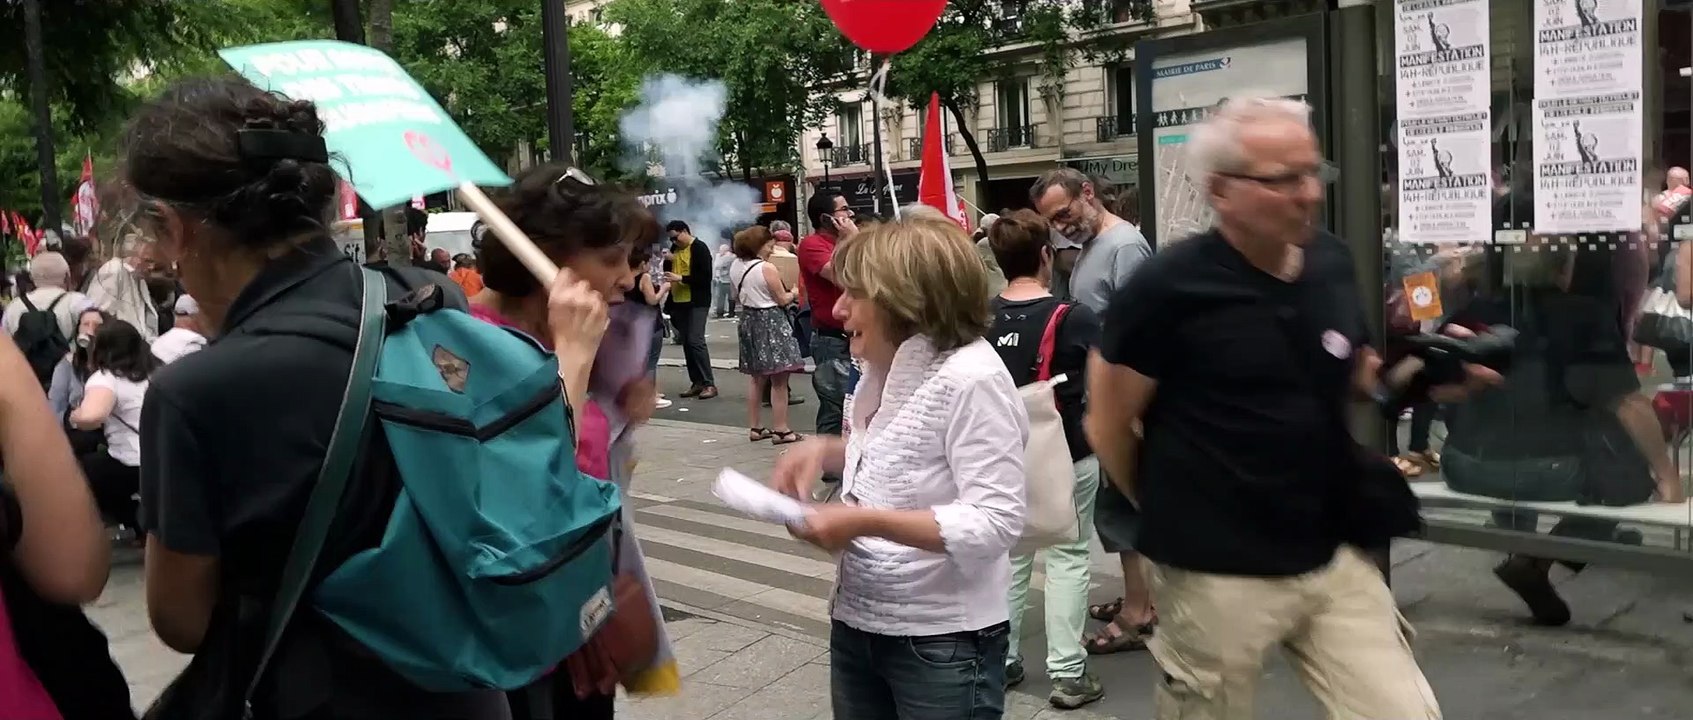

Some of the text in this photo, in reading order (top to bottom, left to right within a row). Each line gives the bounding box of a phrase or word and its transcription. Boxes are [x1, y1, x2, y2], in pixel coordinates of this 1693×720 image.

[1539, 19, 1636, 43] MANIFESTATION
[1400, 46, 1484, 68] MANIFESTATION
[1156, 61, 1217, 77] MAIRIE DE PARIS
[1089, 162, 1108, 176] My
[1540, 158, 1636, 177] MANIFESTATION
[1403, 174, 1486, 191] MANIFESTATION
